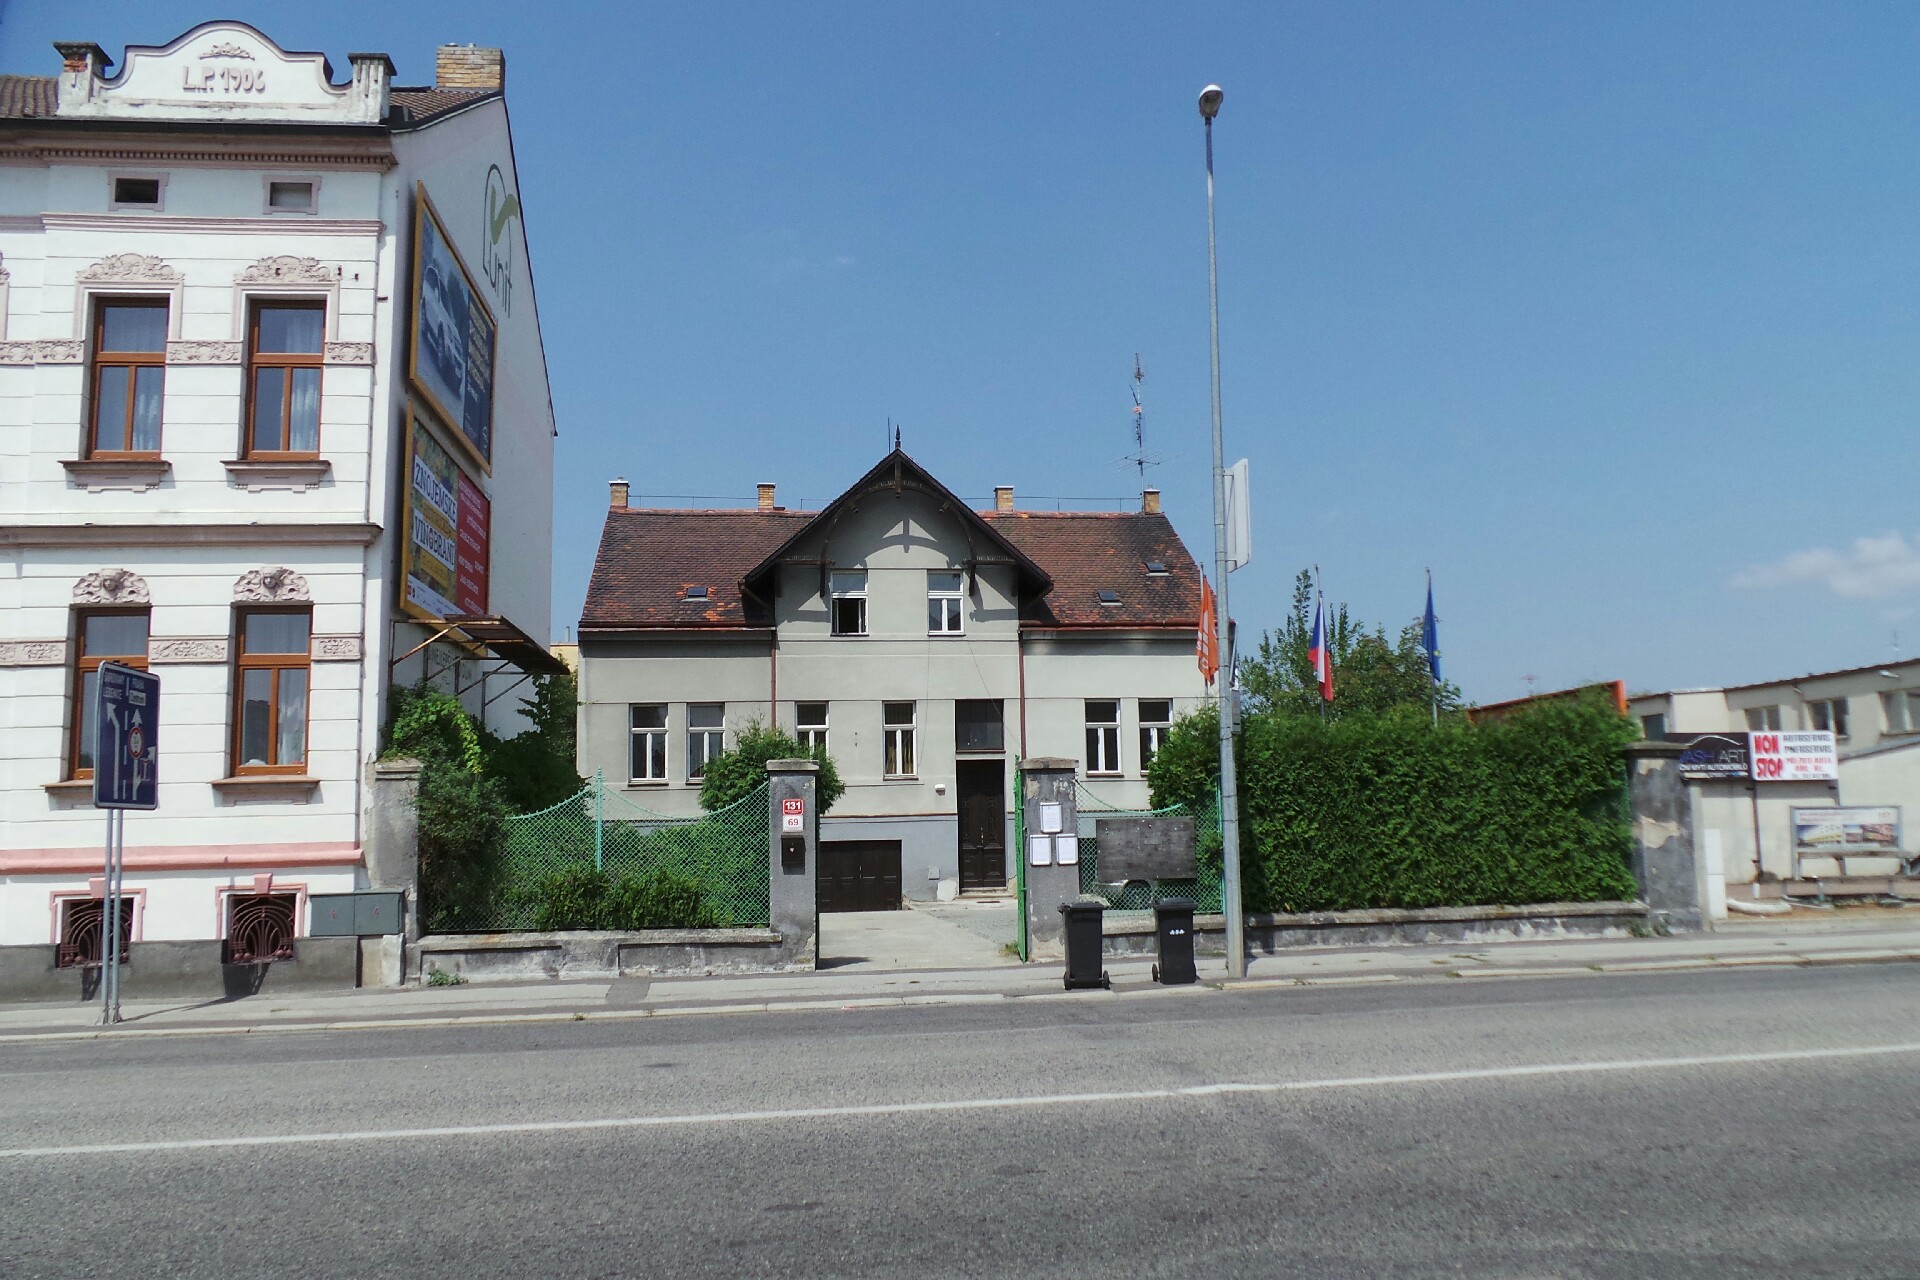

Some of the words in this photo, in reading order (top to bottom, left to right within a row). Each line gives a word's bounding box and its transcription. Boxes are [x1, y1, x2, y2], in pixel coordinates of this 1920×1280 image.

[220, 67, 265, 94] 1906
[1754, 734, 1779, 754] NON
[1719, 749, 1747, 763] ART
[1756, 757, 1784, 778] STOP
[785, 801, 801, 810] 131
[788, 818, 799, 826] 69
